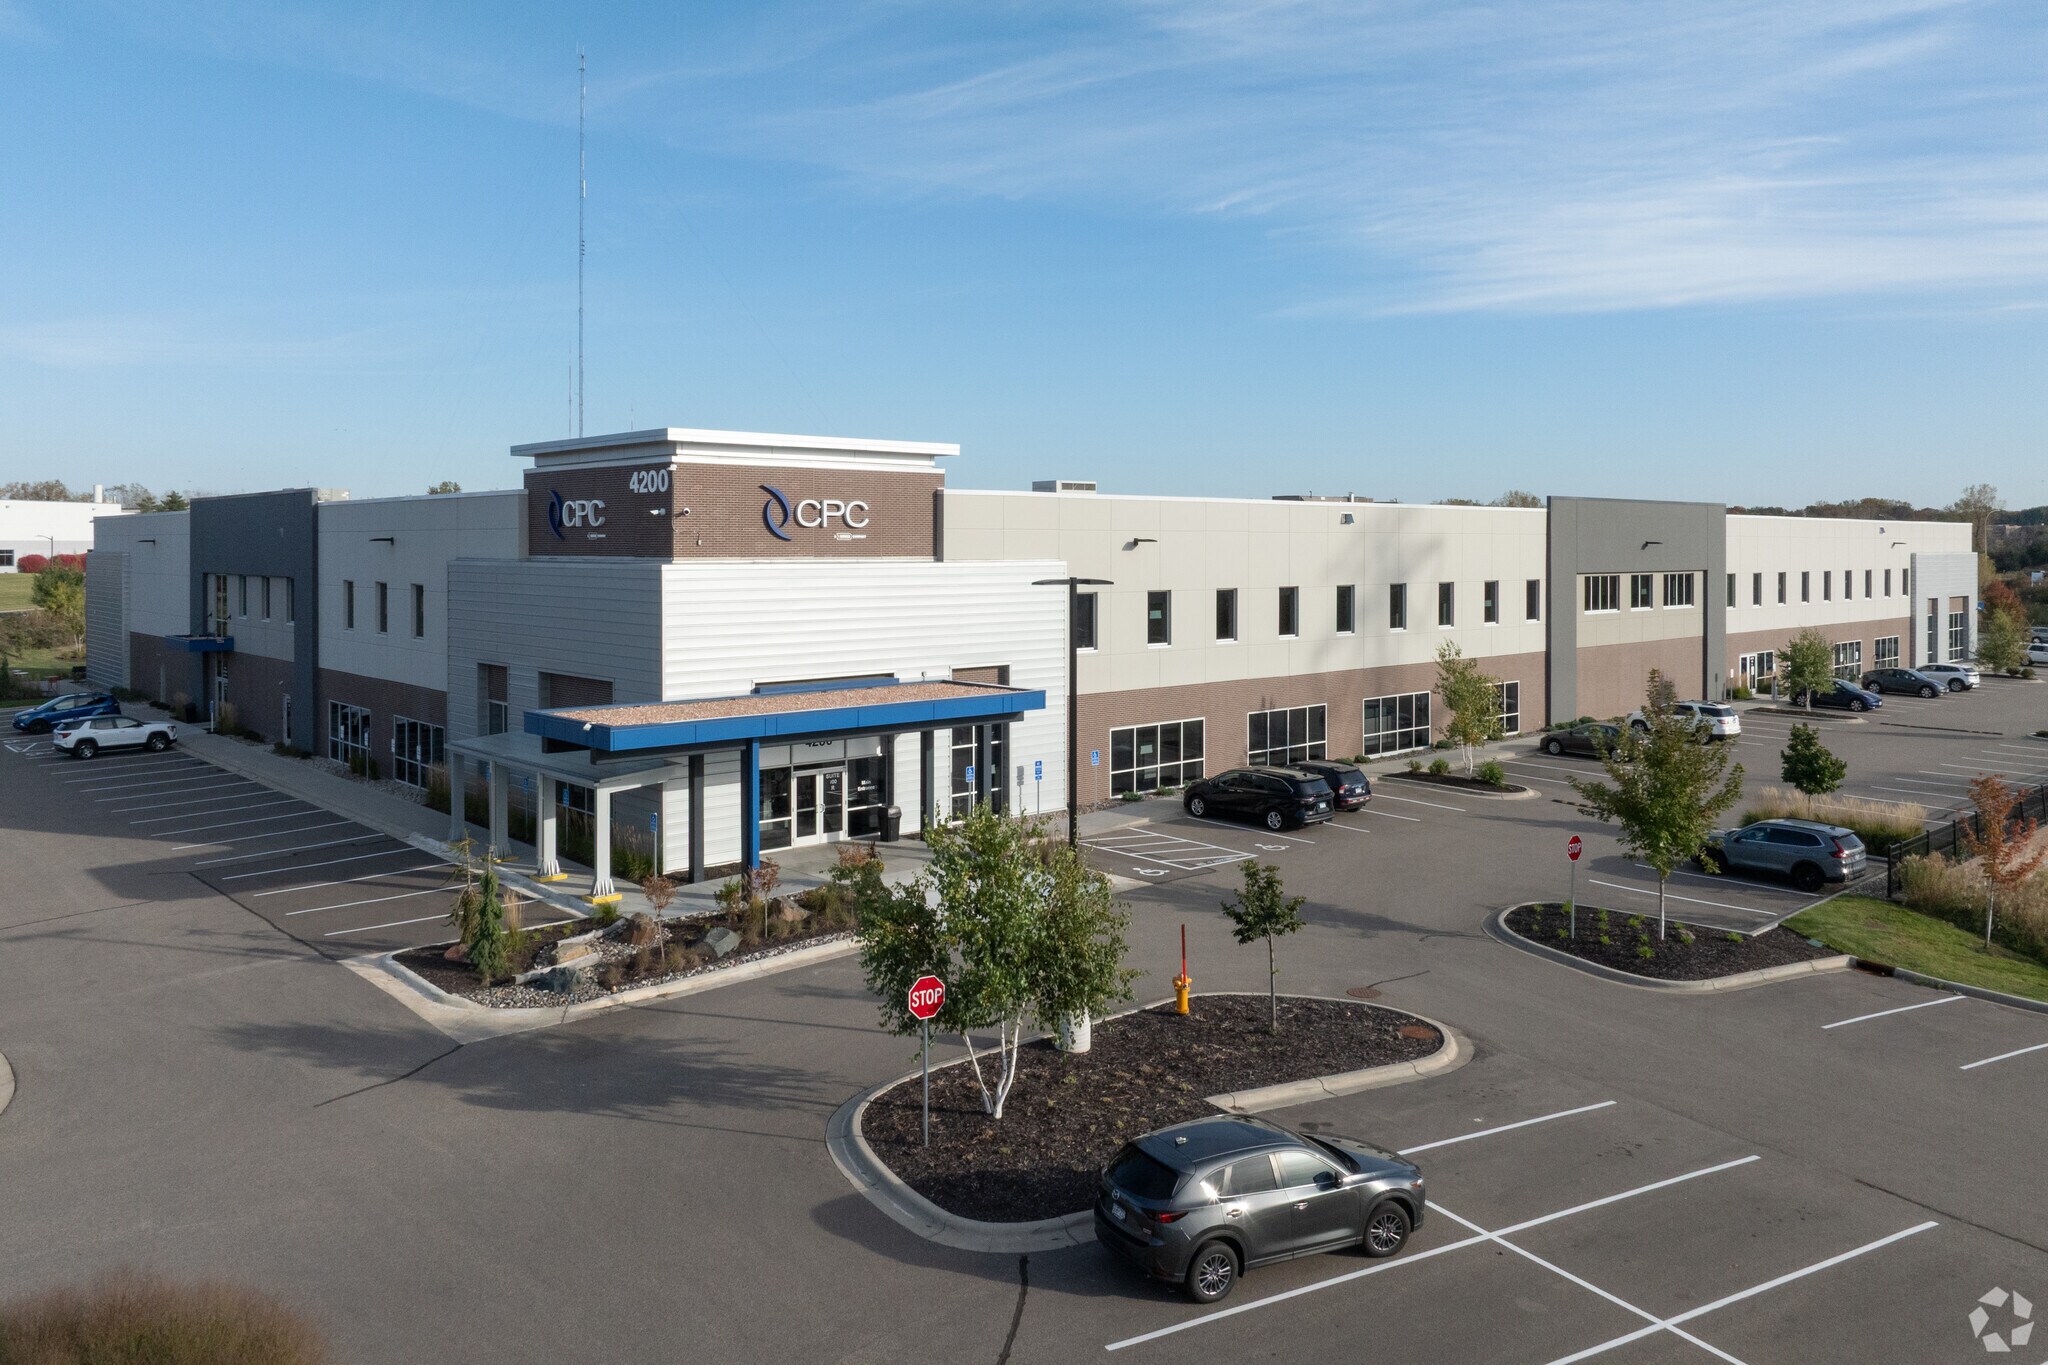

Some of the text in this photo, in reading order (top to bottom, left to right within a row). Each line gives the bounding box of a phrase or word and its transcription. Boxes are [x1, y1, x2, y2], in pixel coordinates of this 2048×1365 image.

[629, 469, 669, 493] 4200
[562, 499, 606, 527] CPC
[797, 499, 870, 528] CPC
[911, 987, 943, 1008] STOP
